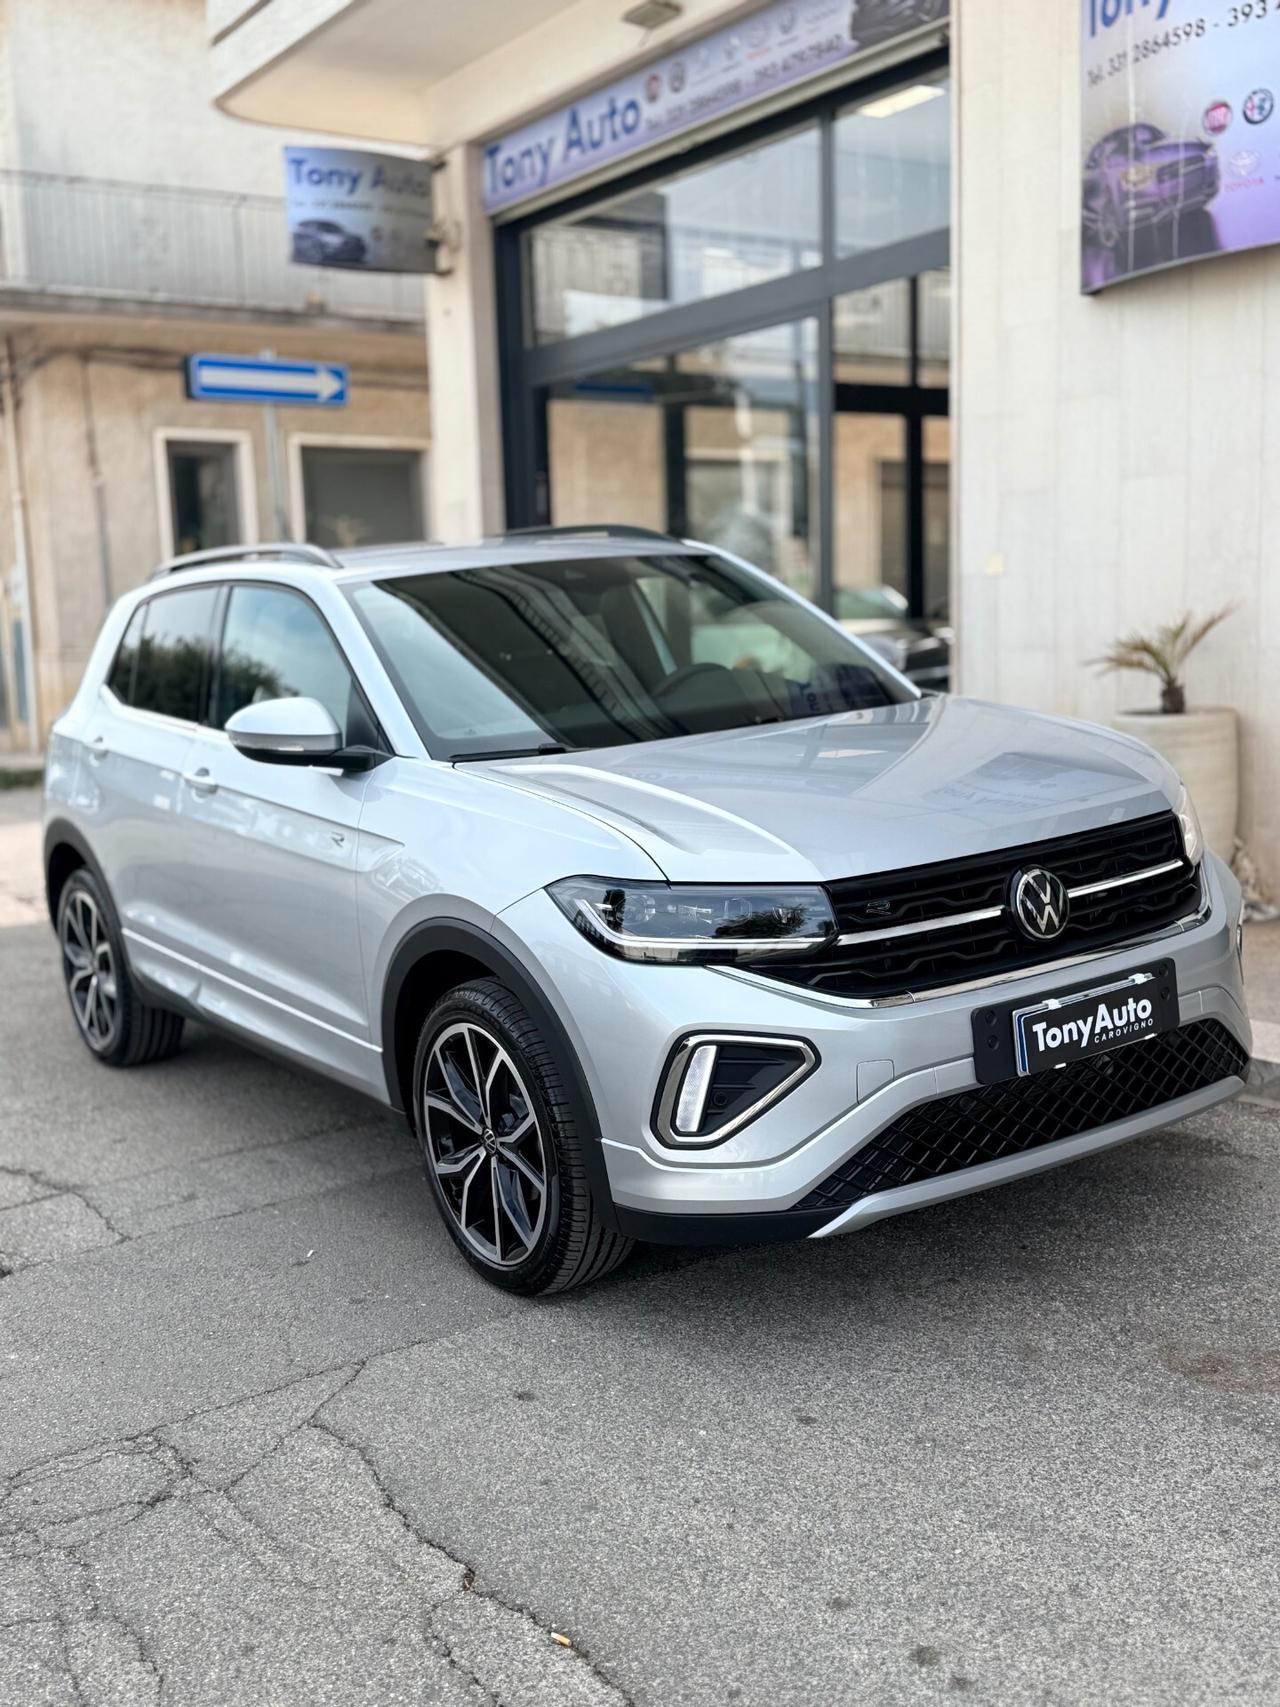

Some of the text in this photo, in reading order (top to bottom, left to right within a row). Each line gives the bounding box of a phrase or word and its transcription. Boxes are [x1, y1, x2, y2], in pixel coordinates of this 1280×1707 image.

[1132, 17, 1206, 64] 2864598
[1227, 0, 1268, 28] 393
[485, 138, 556, 195] Tony
[561, 95, 640, 163] Auto
[289, 158, 362, 195] Tony
[1032, 998, 1153, 1052] TonyAuto
[1094, 1017, 1154, 1044] CAROVIGNO
